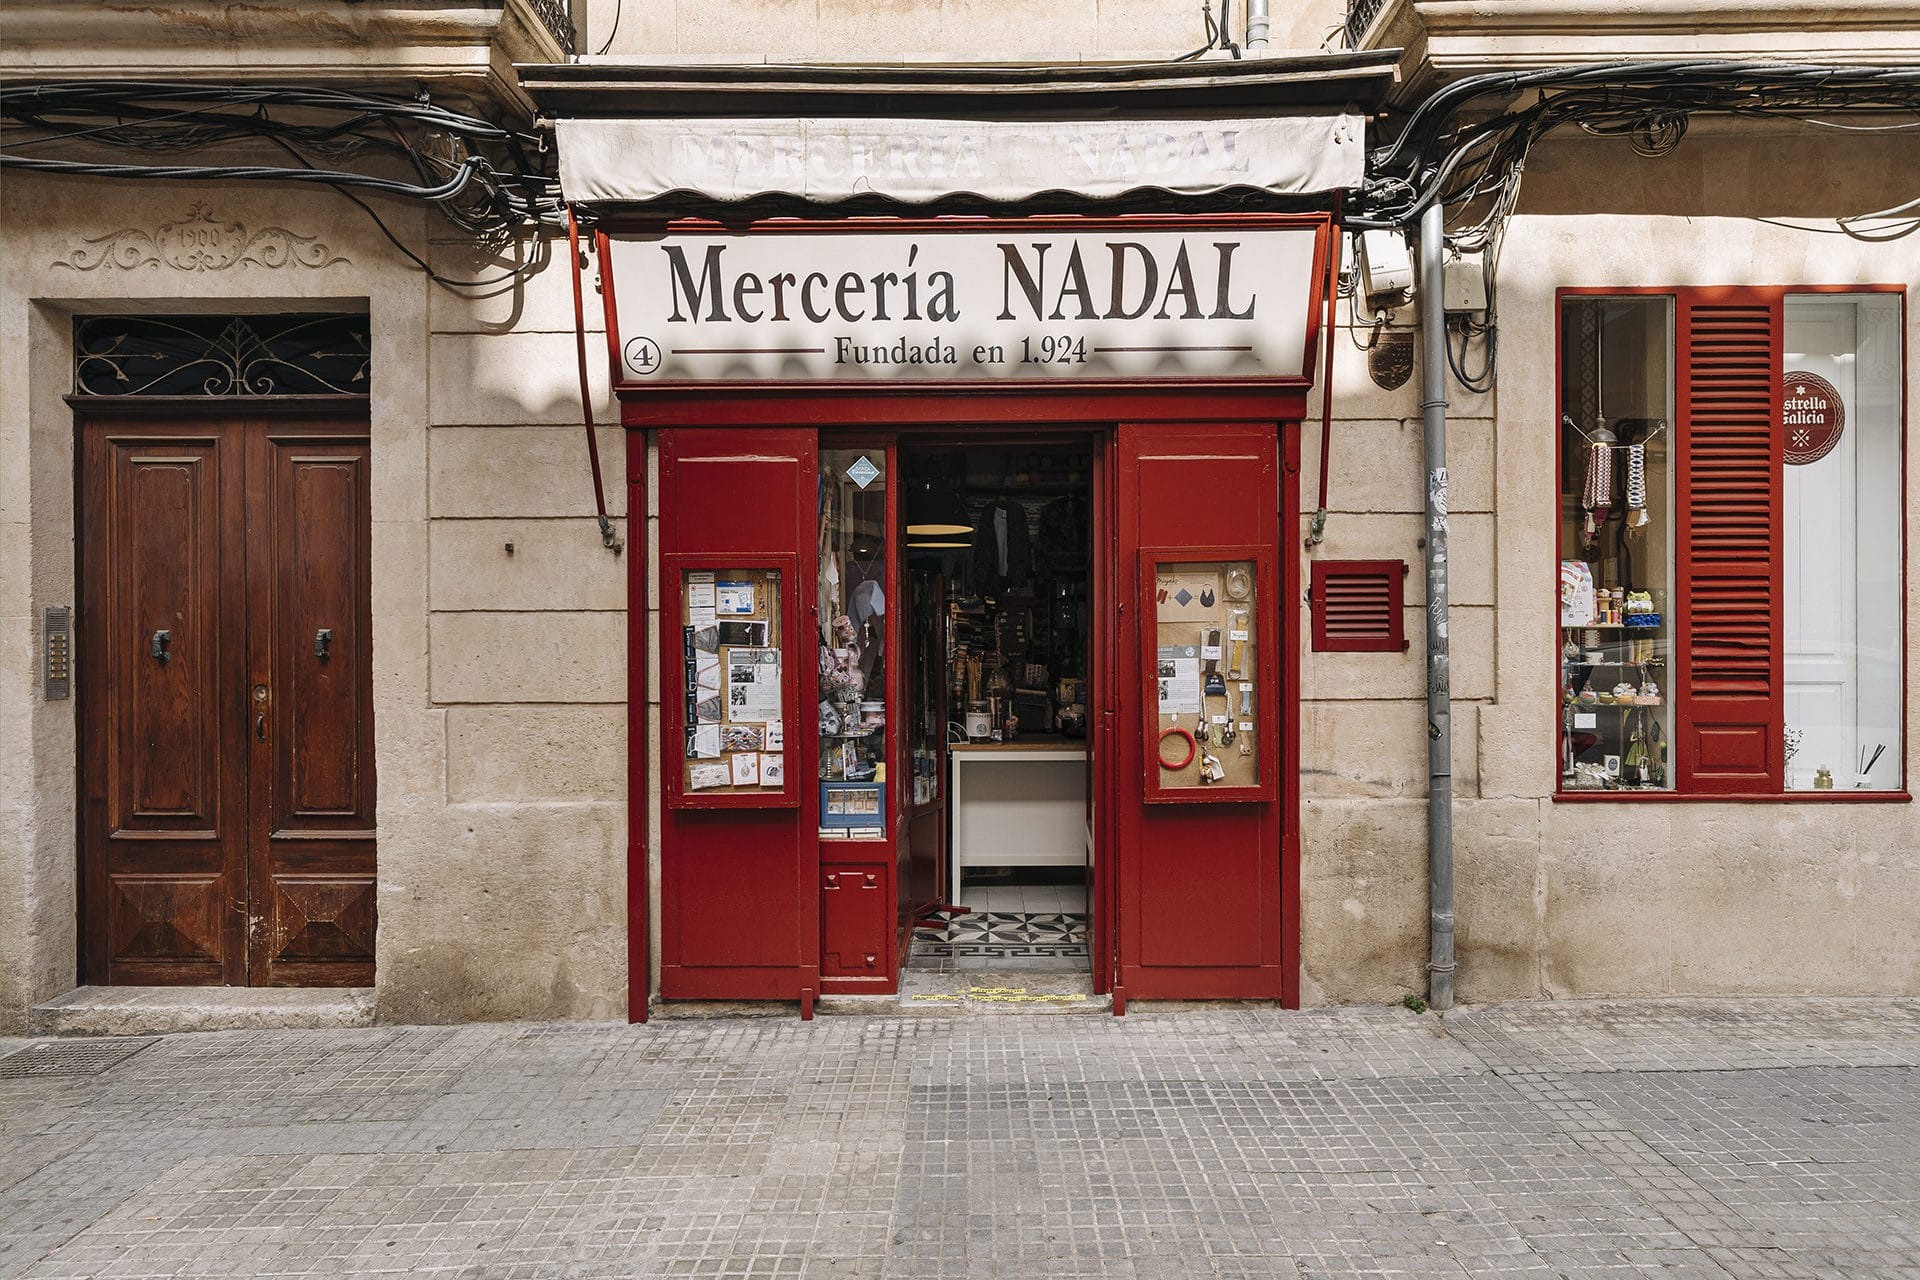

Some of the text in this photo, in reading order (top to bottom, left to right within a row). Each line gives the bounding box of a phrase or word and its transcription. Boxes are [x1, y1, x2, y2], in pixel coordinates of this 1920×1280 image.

[1063, 130, 1250, 176] NADAL
[177, 228, 220, 248] 1900
[661, 238, 1256, 325] Mercería NADAL
[632, 344, 654, 367] 4
[834, 335, 1088, 365] Fundada en 1.924
[1783, 396, 1827, 410] strella
